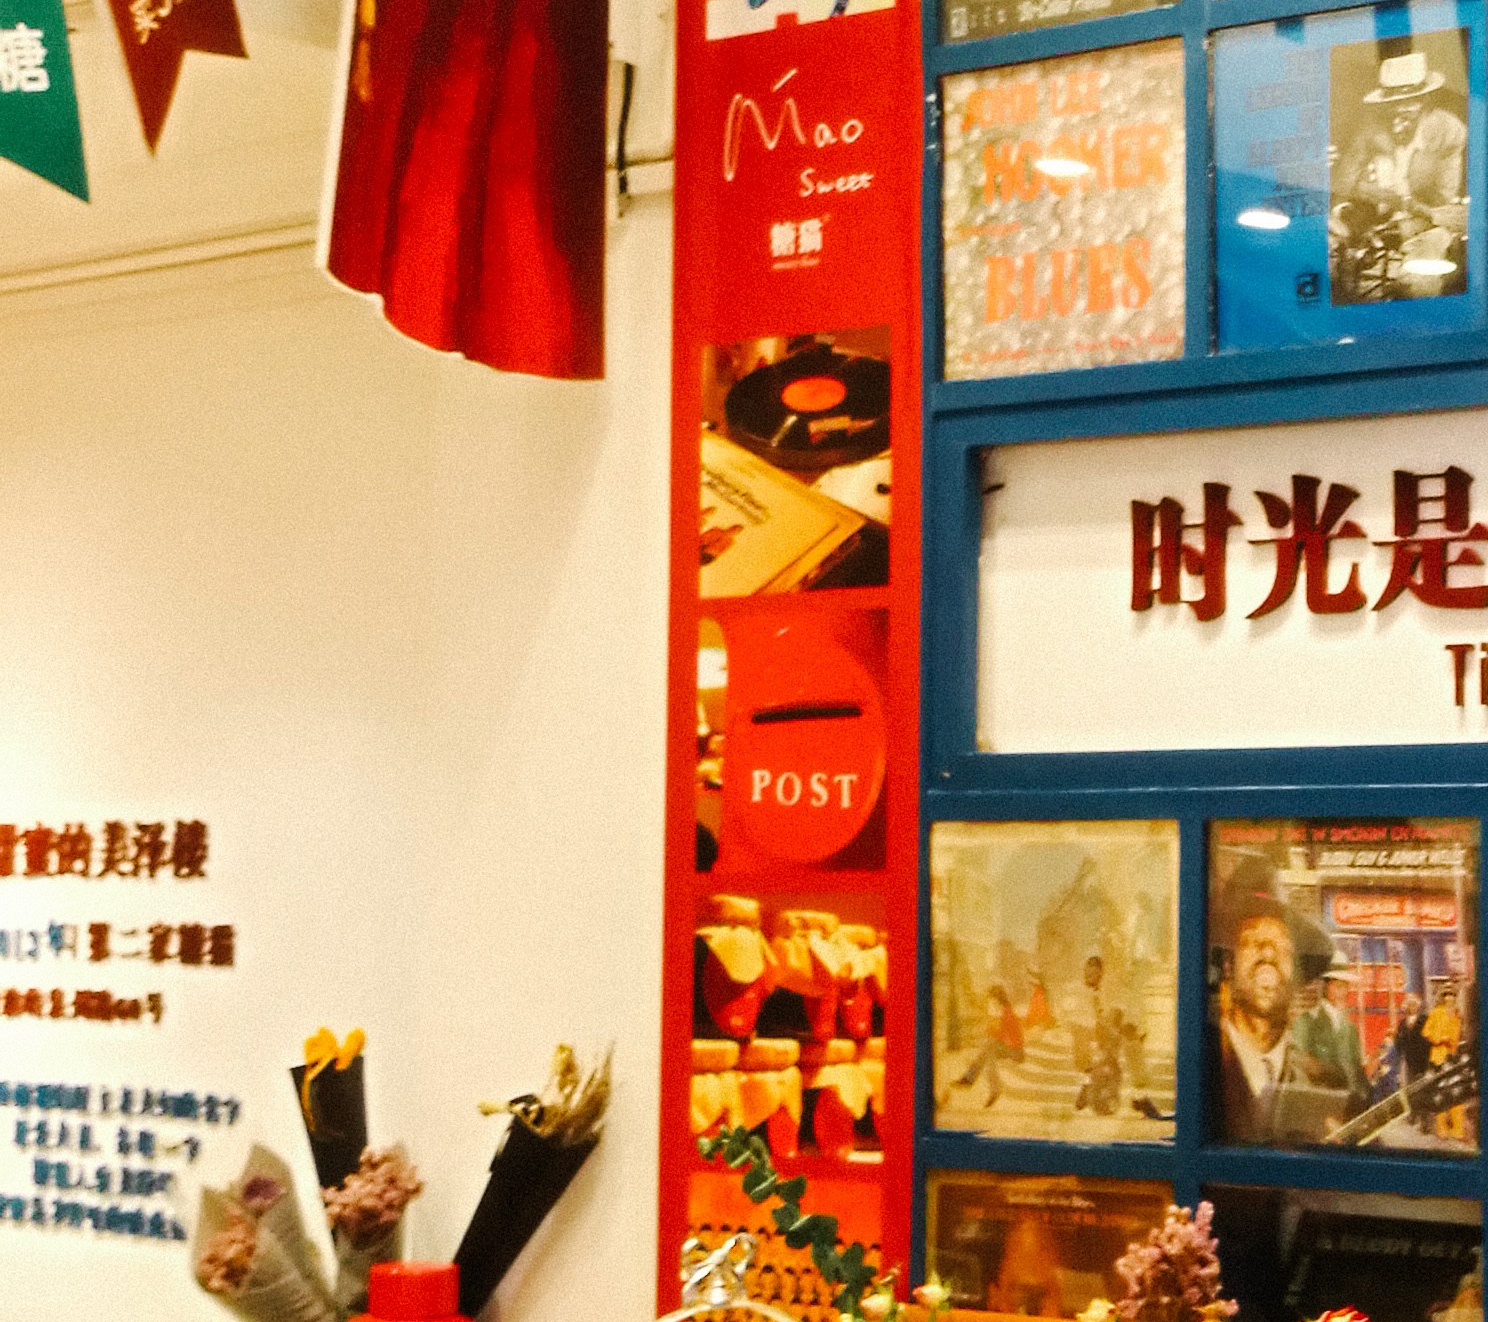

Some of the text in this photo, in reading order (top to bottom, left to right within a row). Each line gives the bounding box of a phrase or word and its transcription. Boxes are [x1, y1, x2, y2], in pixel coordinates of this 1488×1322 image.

[799, 167, 875, 198] Sweet
[983, 238, 1153, 324] BLUES
[751, 768, 859, 809] POST
